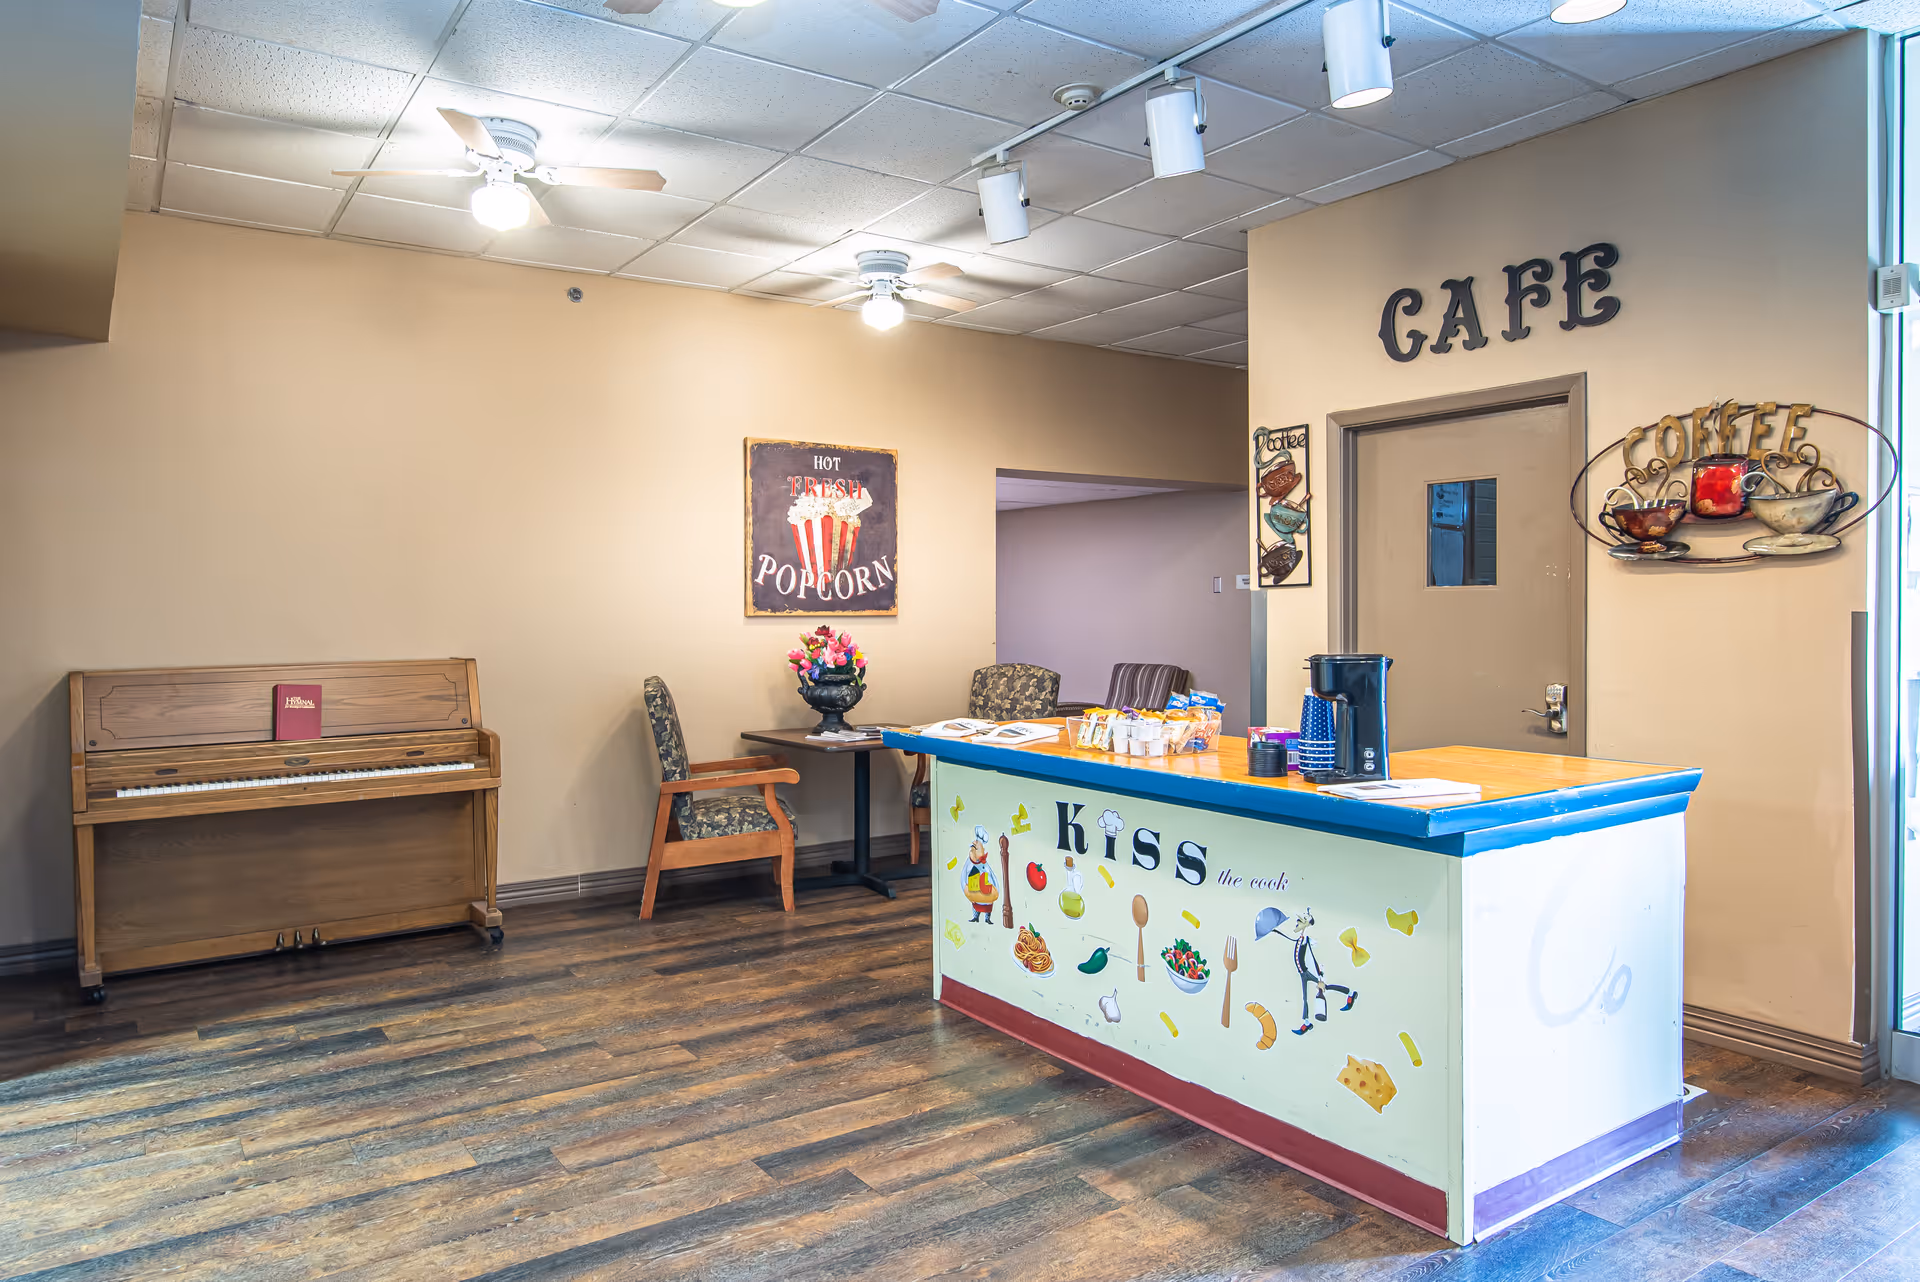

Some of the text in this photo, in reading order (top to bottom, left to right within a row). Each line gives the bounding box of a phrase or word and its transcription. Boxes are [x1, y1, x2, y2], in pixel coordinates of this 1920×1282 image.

[1378, 242, 1621, 362] CAFE
[1267, 431, 1306, 452] coffee
[1622, 401, 1813, 477] COFFEE
[813, 455, 841, 471] HOT
[787, 475, 862, 499] FRESH
[754, 554, 894, 601] POPCORN
[285, 697, 315, 706] HYMNAL
[1217, 869, 1243, 888] the
[1250, 871, 1289, 892] cook
